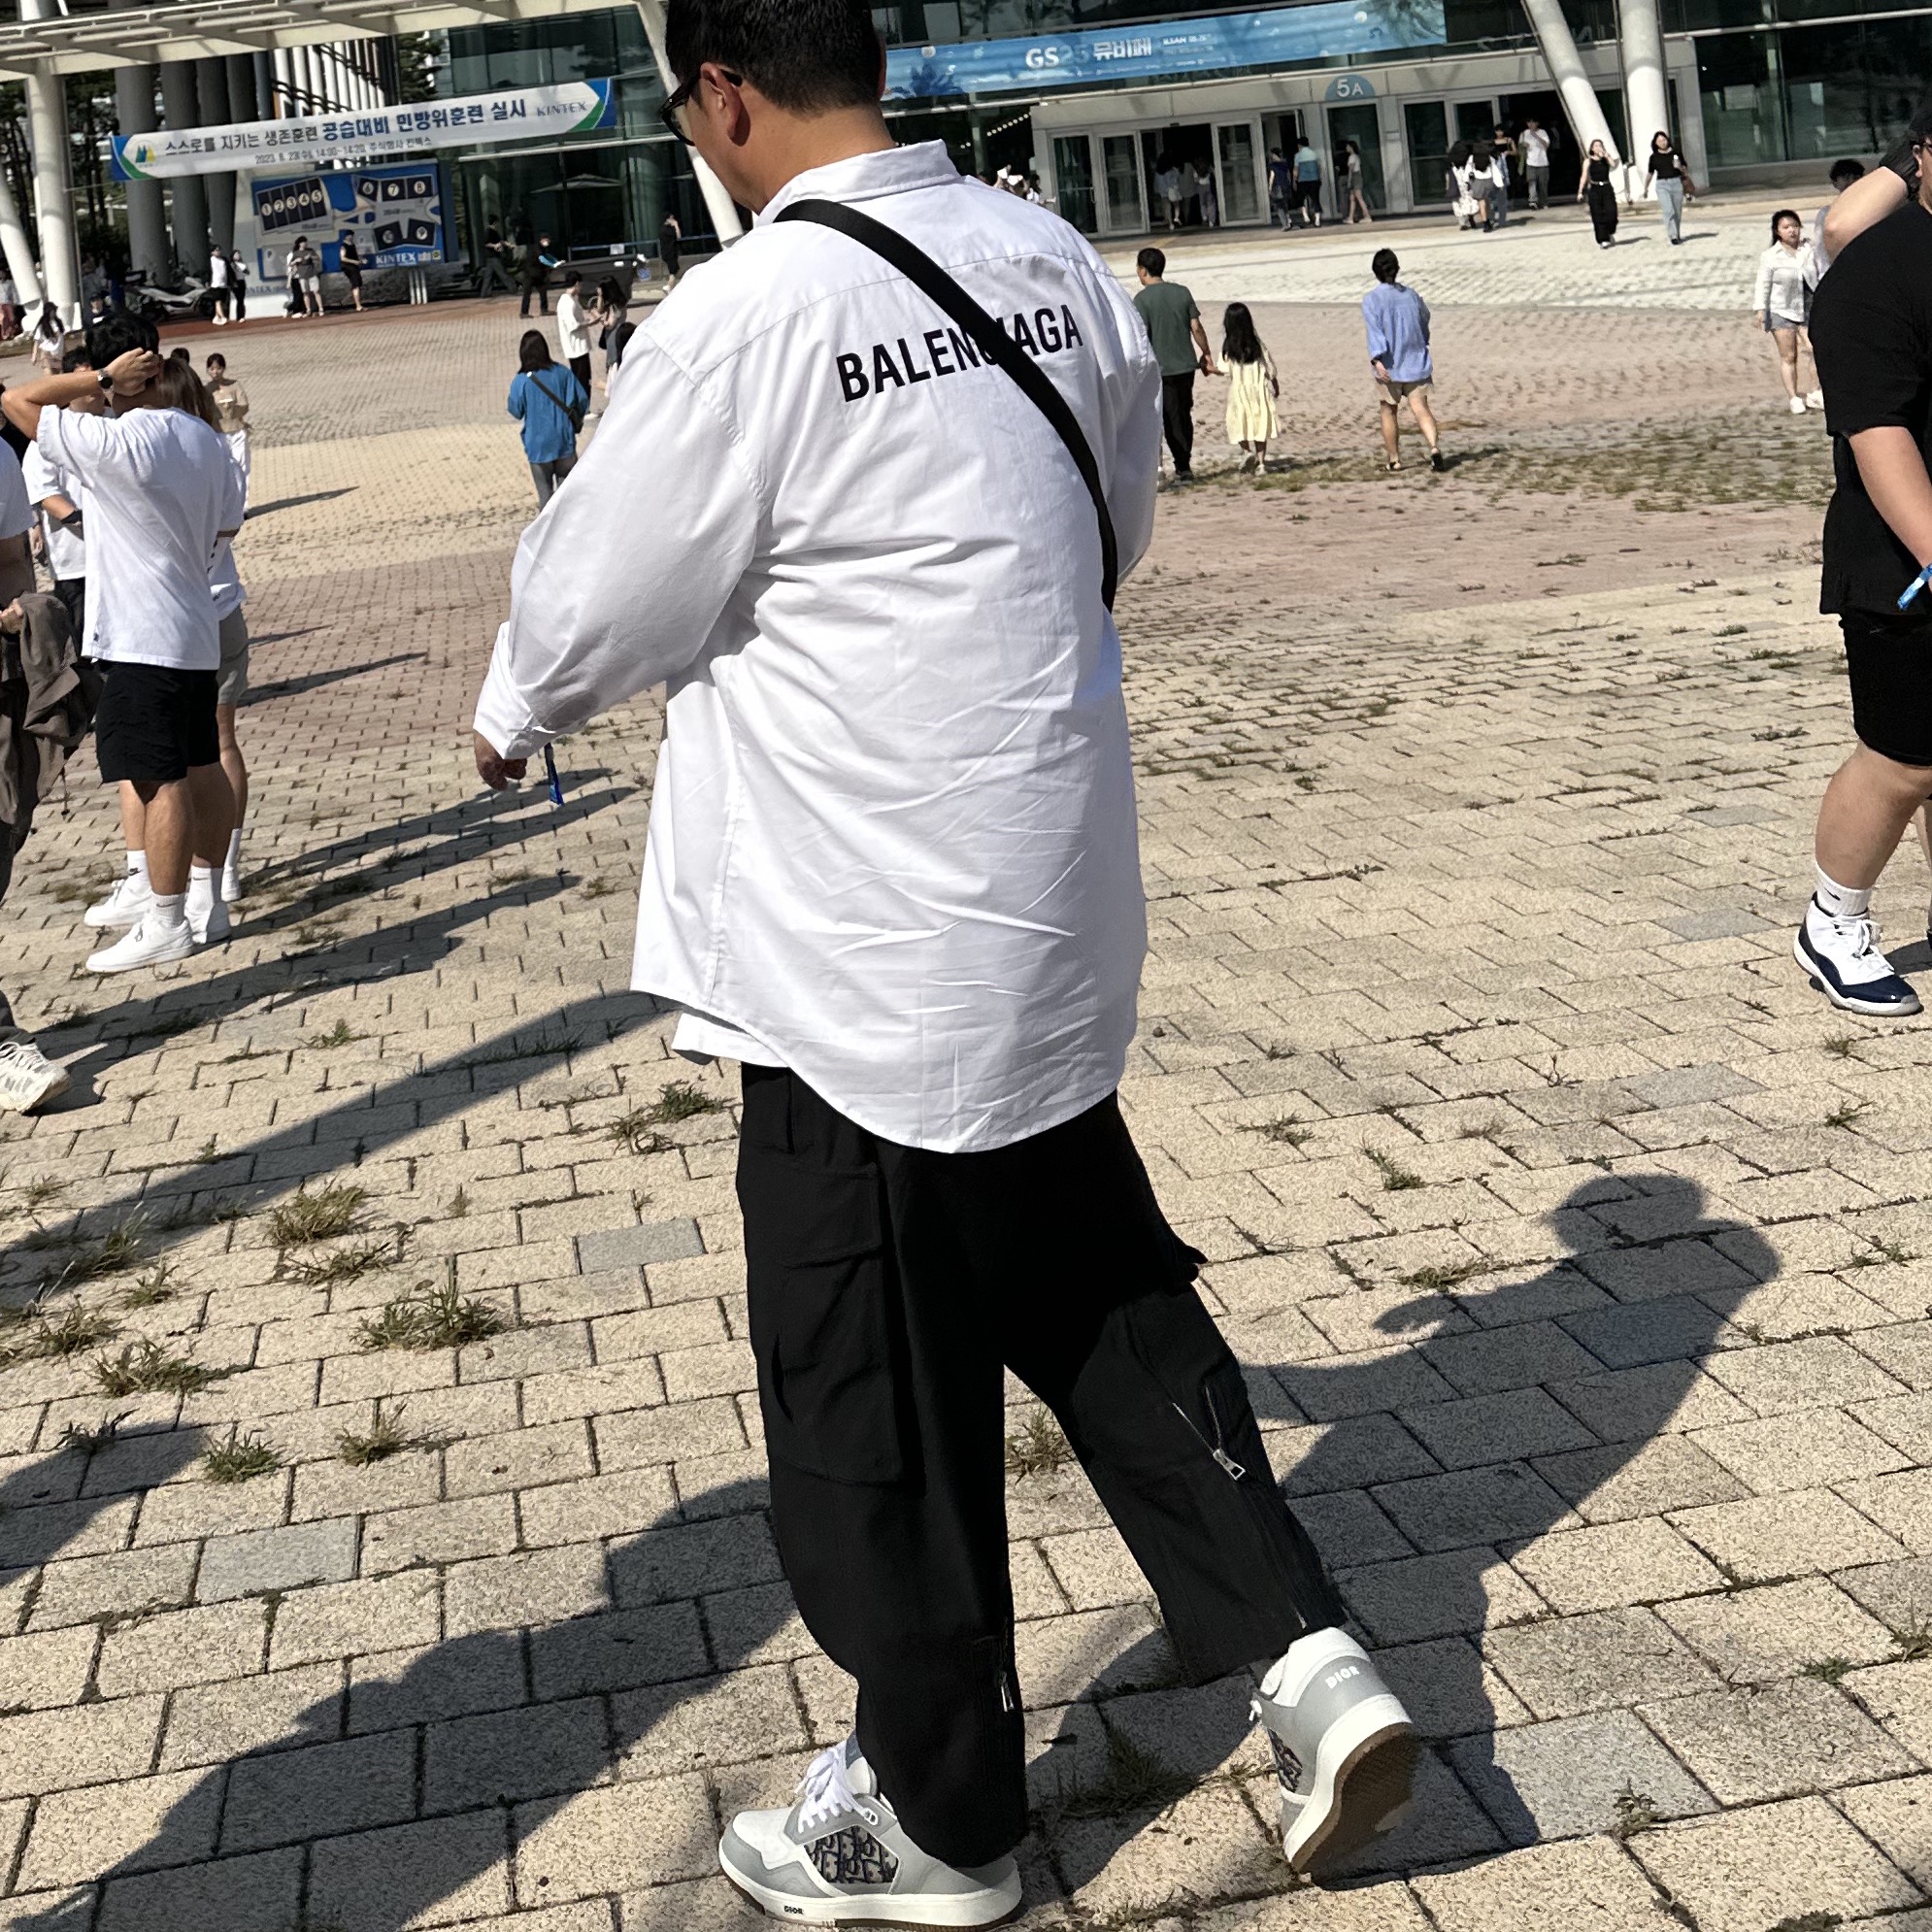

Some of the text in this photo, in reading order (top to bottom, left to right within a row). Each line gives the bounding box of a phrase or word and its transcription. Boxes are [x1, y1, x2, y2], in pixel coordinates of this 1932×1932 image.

[1336, 79, 1364, 98] 5A
[536, 100, 588, 117] KINTEX
[164, 98, 527, 156] 스스로를 지키는 생존훈련 공습대비 민방위훈련 실시
[376, 251, 416, 265] KINTEX
[1325, 1665, 1360, 1689] DIOR
[783, 1905, 805, 1915] DIOR
